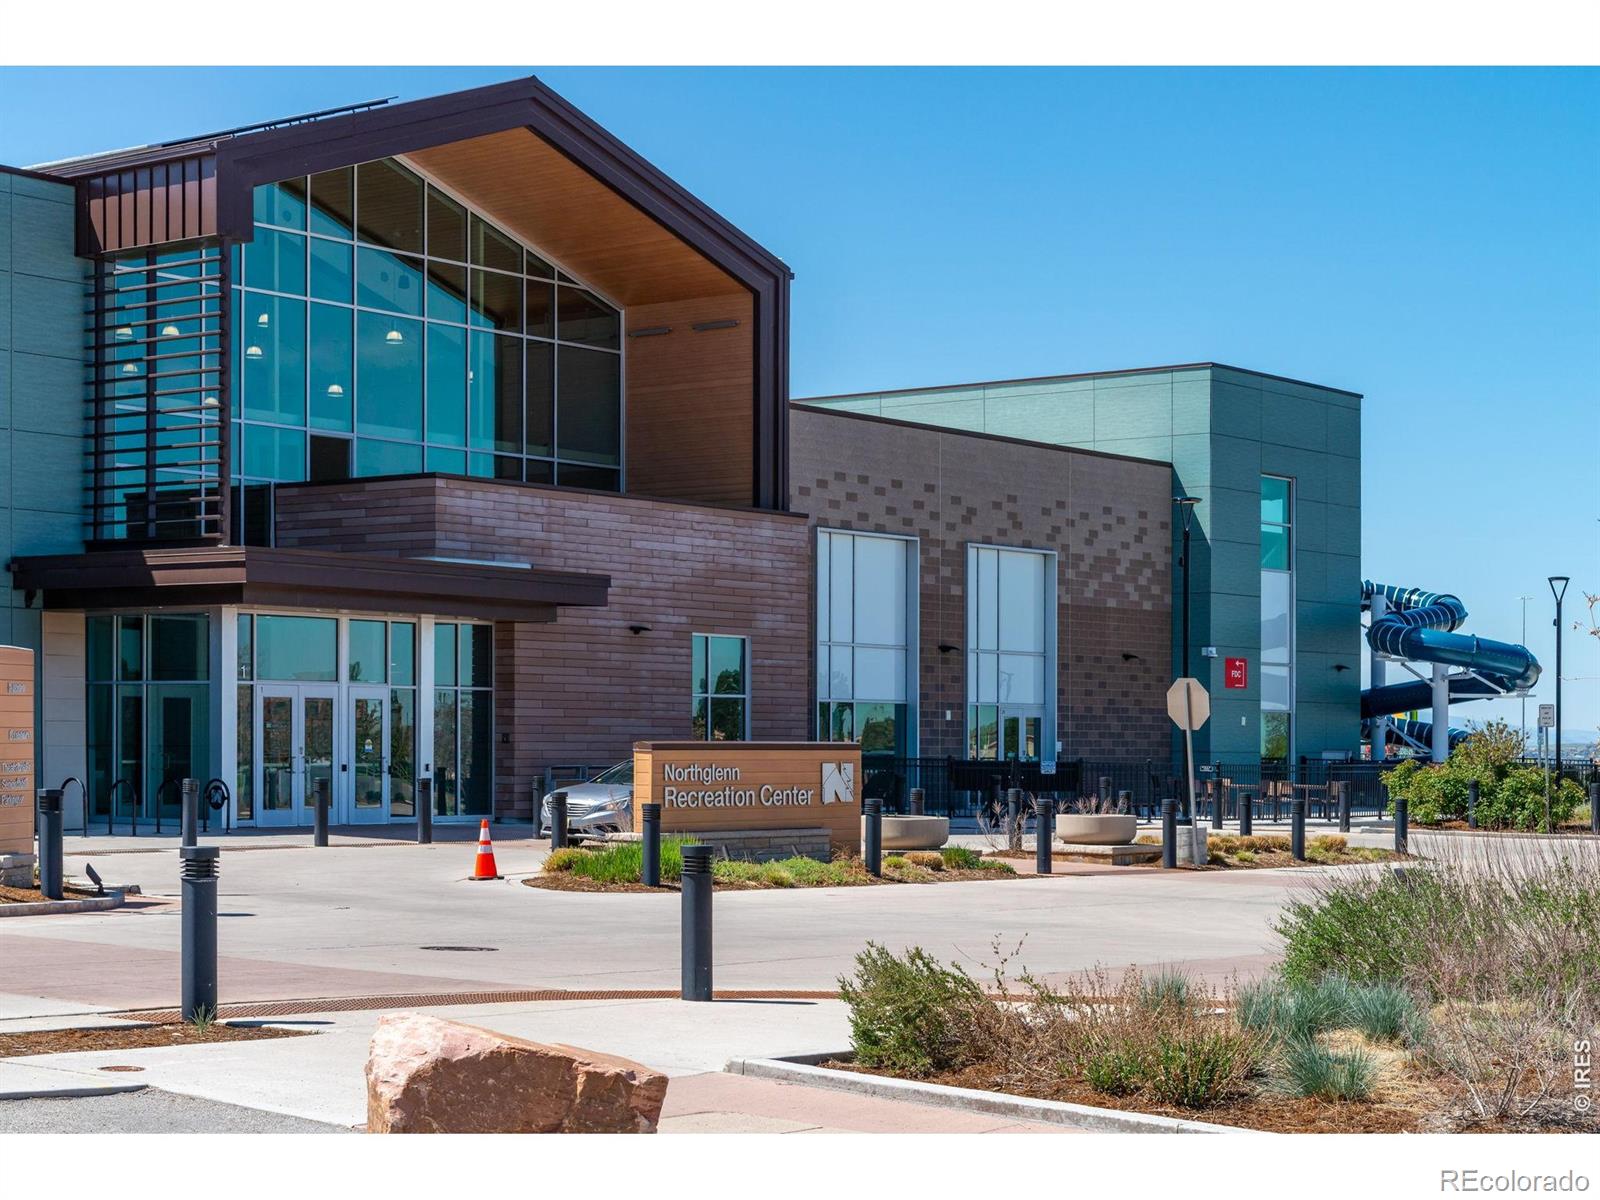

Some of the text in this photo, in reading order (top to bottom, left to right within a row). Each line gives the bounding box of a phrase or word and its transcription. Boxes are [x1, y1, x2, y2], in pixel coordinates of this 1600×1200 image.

[1231, 670, 1242, 678] FDC
[664, 763, 740, 785] Northglenn
[664, 785, 813, 808] Recreation Center
